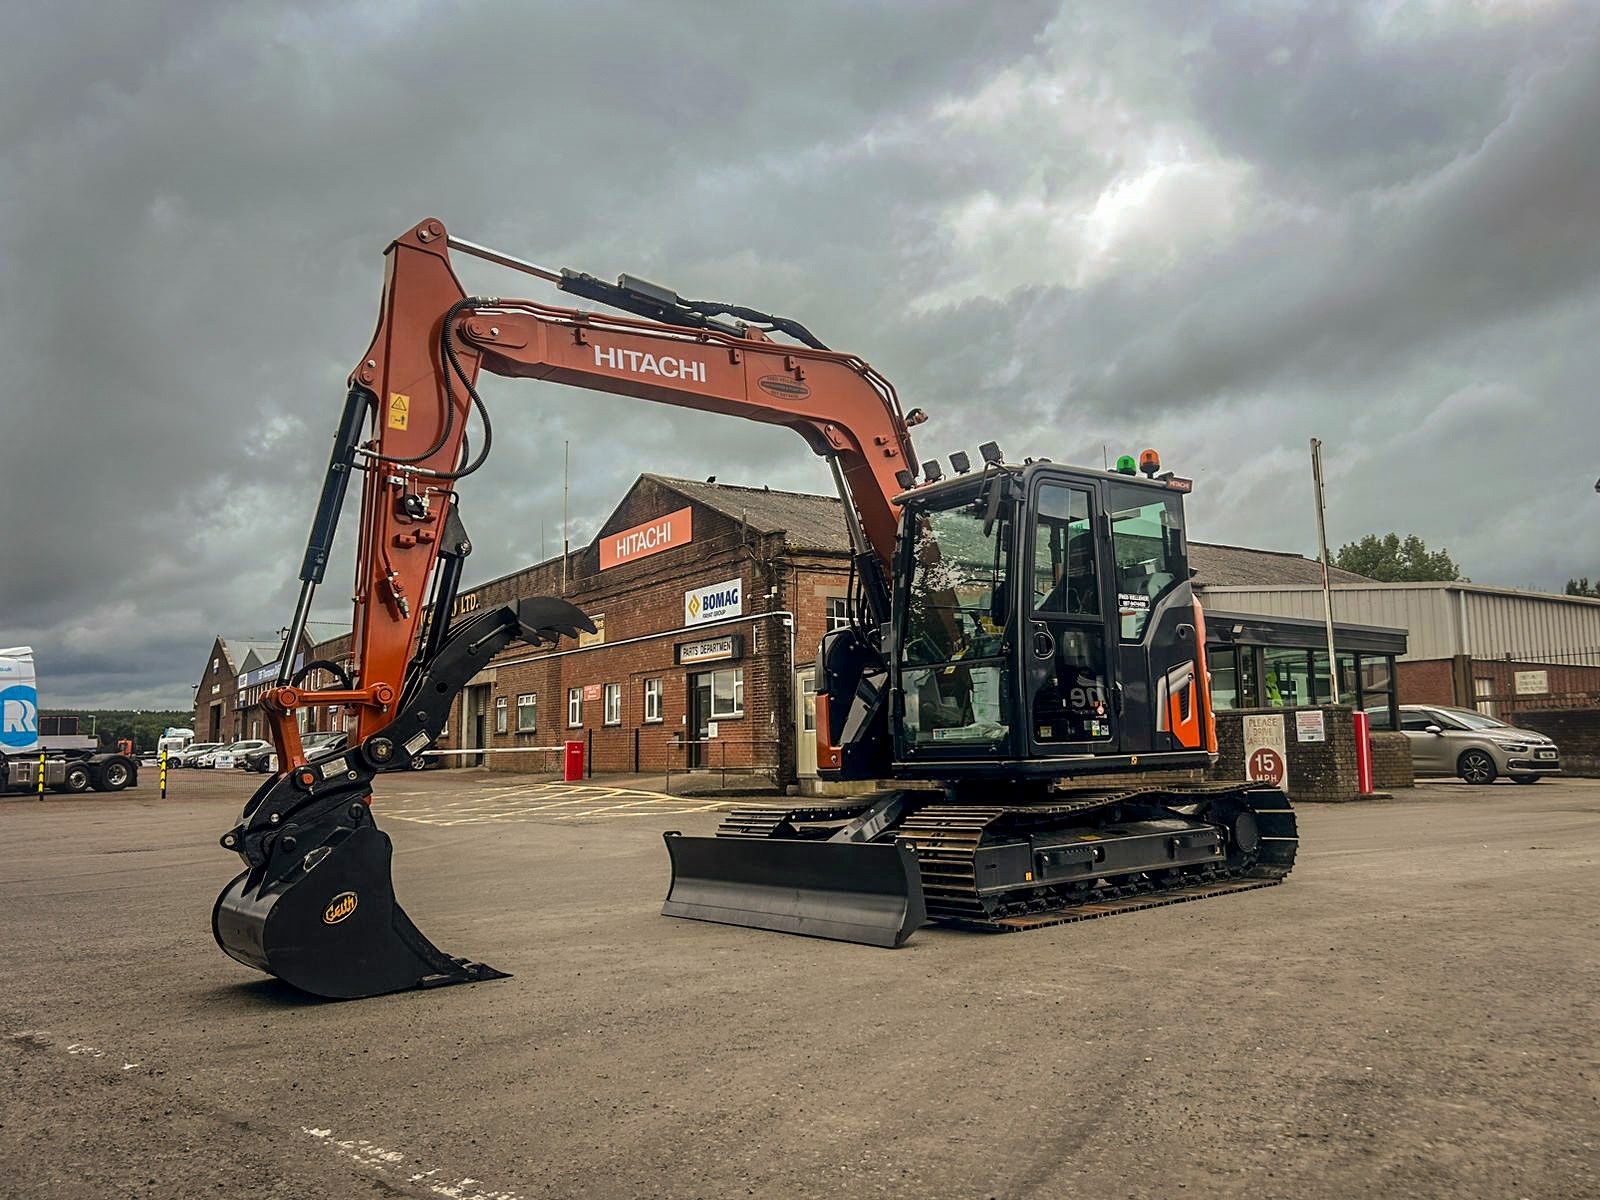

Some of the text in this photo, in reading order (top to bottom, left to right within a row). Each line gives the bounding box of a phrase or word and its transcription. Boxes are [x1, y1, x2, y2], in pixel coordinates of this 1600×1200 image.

[594, 344, 706, 383] HITACHI
[616, 521, 672, 559] HITACHI
[460, 593, 479, 613] LTD.
[702, 588, 739, 611] BOMAG
[682, 641, 732, 656] PARTS DEPARTMEN
[1248, 718, 1278, 727] PLEASE
[1253, 728, 1273, 736] DRIVE
[1255, 753, 1275, 772] 15
